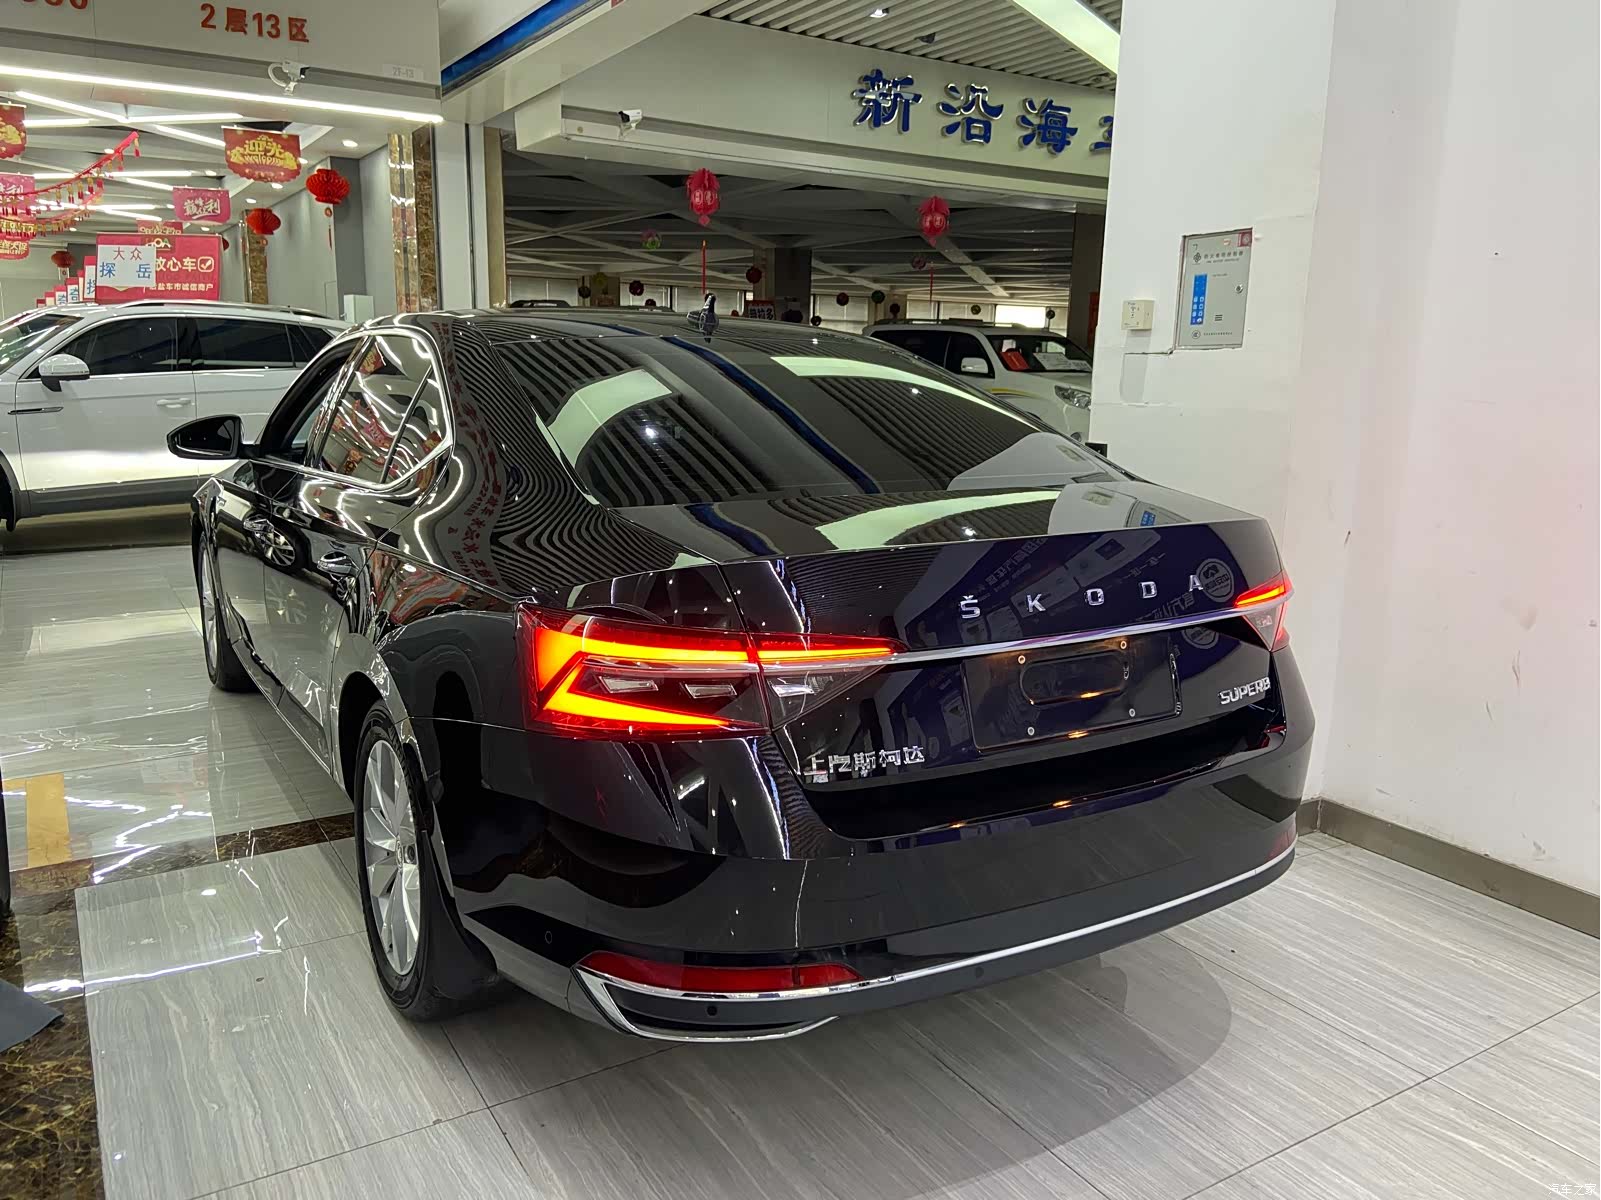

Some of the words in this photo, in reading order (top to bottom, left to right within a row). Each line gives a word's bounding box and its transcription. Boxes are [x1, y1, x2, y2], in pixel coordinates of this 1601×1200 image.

[200, 3, 309, 43] 2层13区
[113, 247, 142, 261] 大众
[959, 574, 1205, 620] ŠKODA
[1218, 676, 1271, 705] SUPERB
[803, 745, 925, 777] 上汽斯柯达
